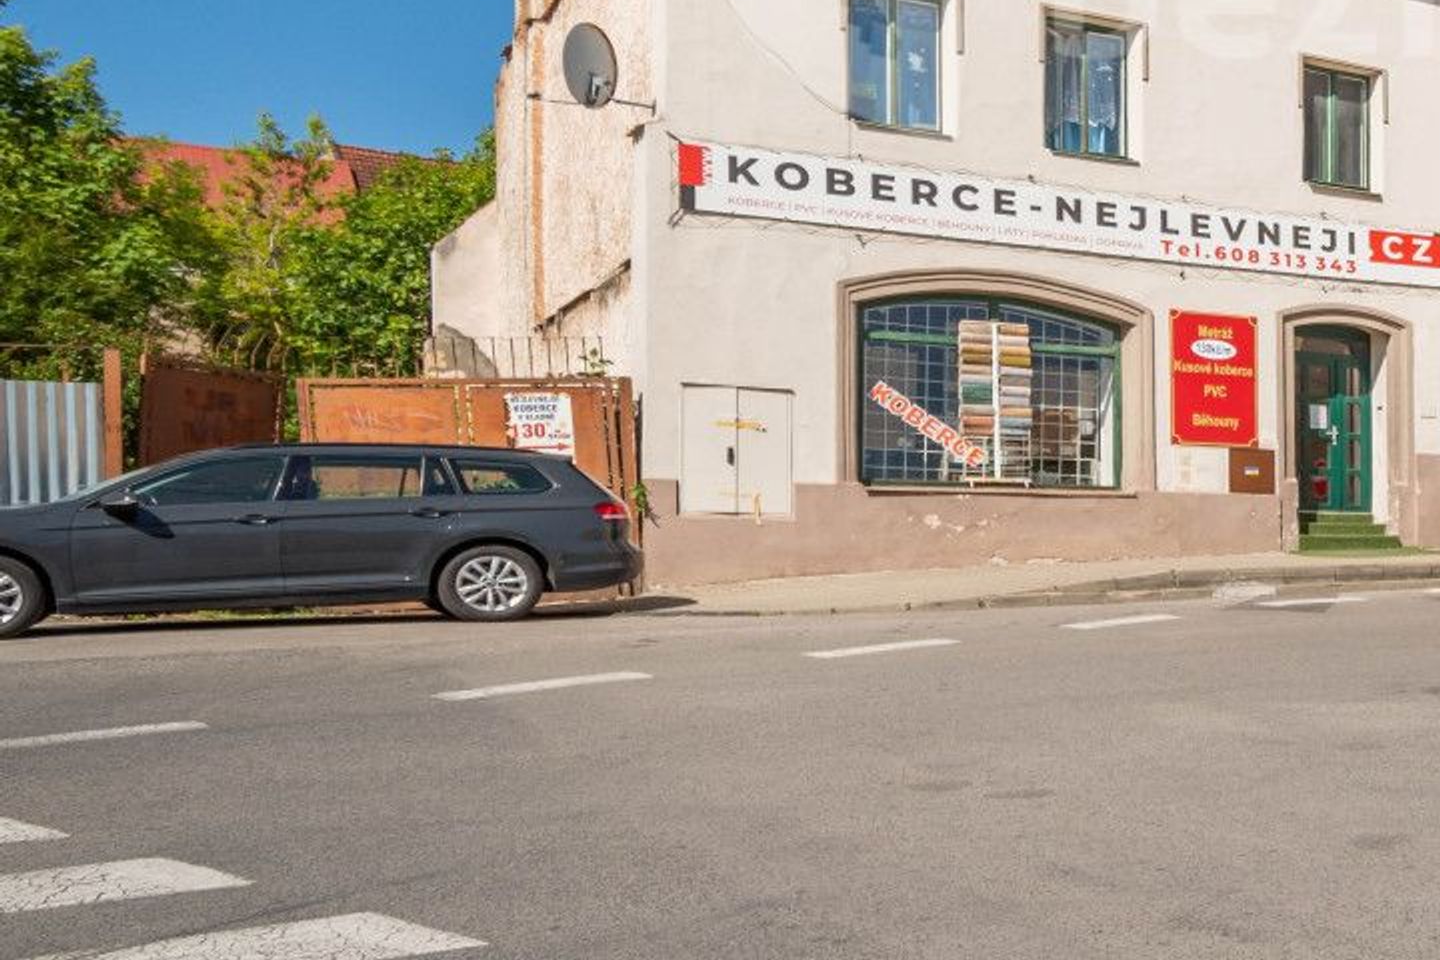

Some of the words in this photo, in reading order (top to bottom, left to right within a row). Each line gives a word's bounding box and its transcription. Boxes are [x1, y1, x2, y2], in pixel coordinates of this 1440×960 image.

[1269, 251, 1308, 270] 313
[1316, 256, 1358, 274] 343
[1203, 384, 1228, 398] PVC
[870, 379, 989, 470] KOBERCE
